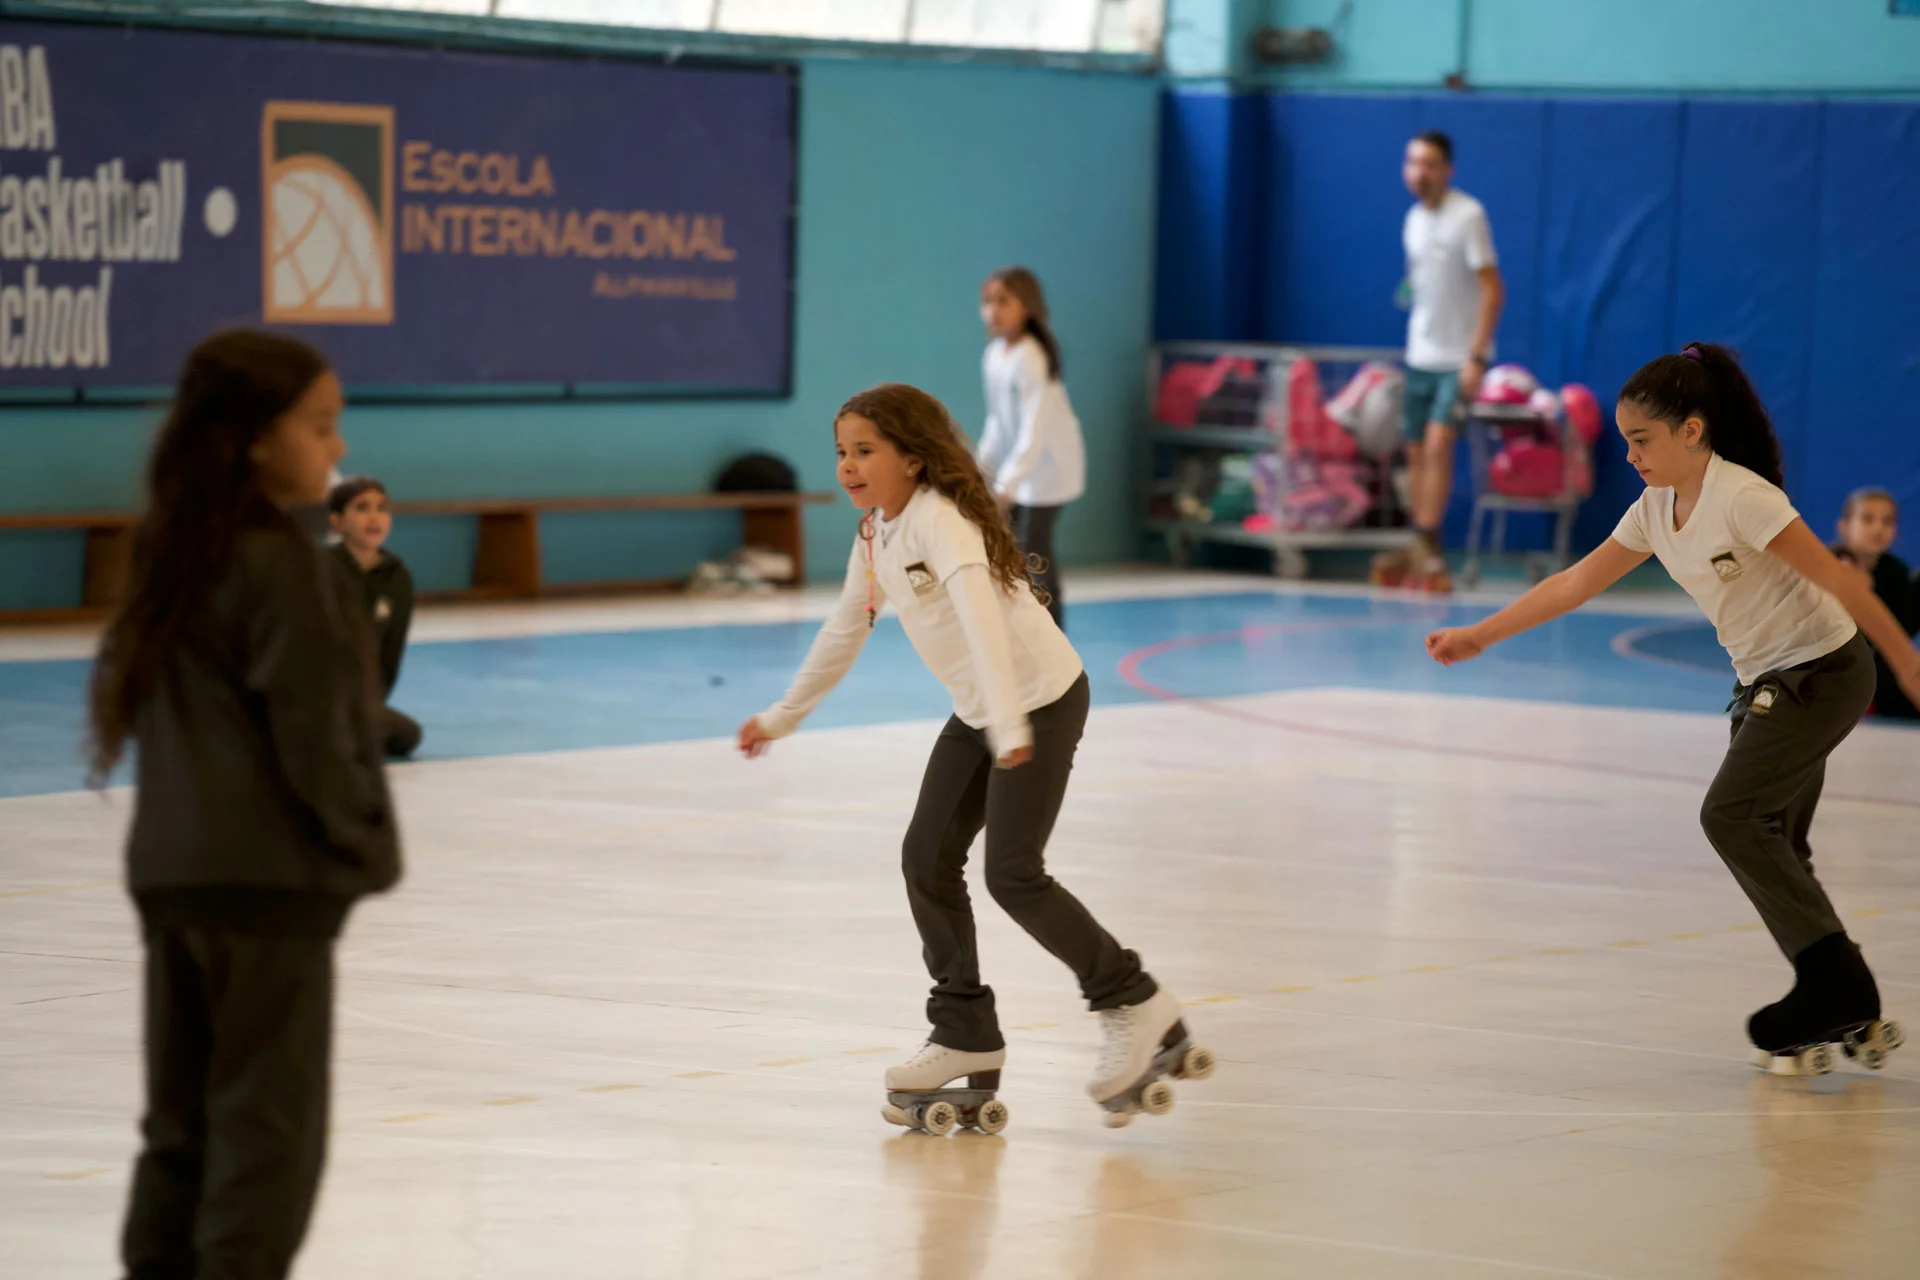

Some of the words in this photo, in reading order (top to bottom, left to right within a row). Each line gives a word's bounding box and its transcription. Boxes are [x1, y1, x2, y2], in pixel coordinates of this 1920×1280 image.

[0, 44, 56, 151] BA
[0, 155, 186, 262] asketball
[401, 204, 737, 262] INTERNACIONAL
[0, 264, 112, 368] chool
